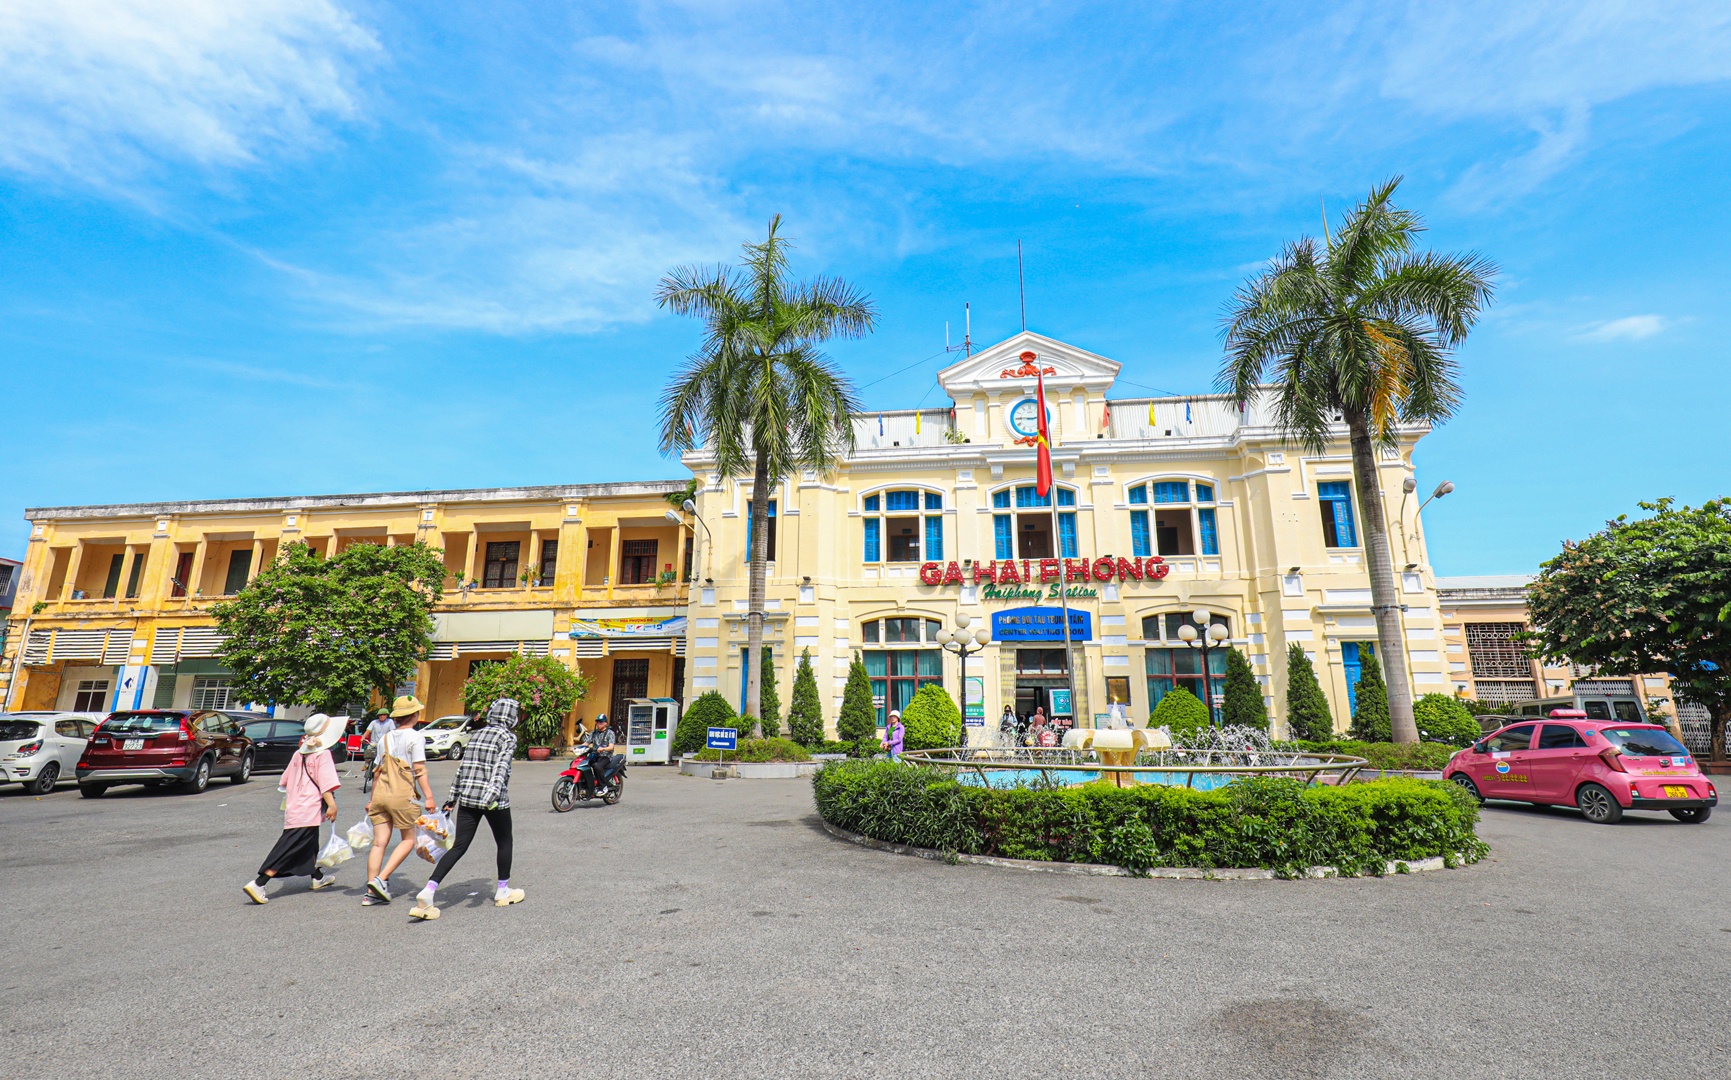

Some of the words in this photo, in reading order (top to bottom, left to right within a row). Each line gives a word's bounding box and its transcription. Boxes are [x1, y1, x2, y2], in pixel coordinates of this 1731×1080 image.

[919, 560, 965, 585] GA
[973, 559, 1031, 583] HAI
[1039, 555, 1170, 582] PHONG
[982, 583, 1043, 603] Haiphong
[1048, 583, 1097, 598] Sation
[1047, 615, 1066, 625] TRUN
[1070, 613, 1084, 625] TÂM
[999, 628, 1027, 636] CENTER
[1029, 628, 1060, 636] WAITING
